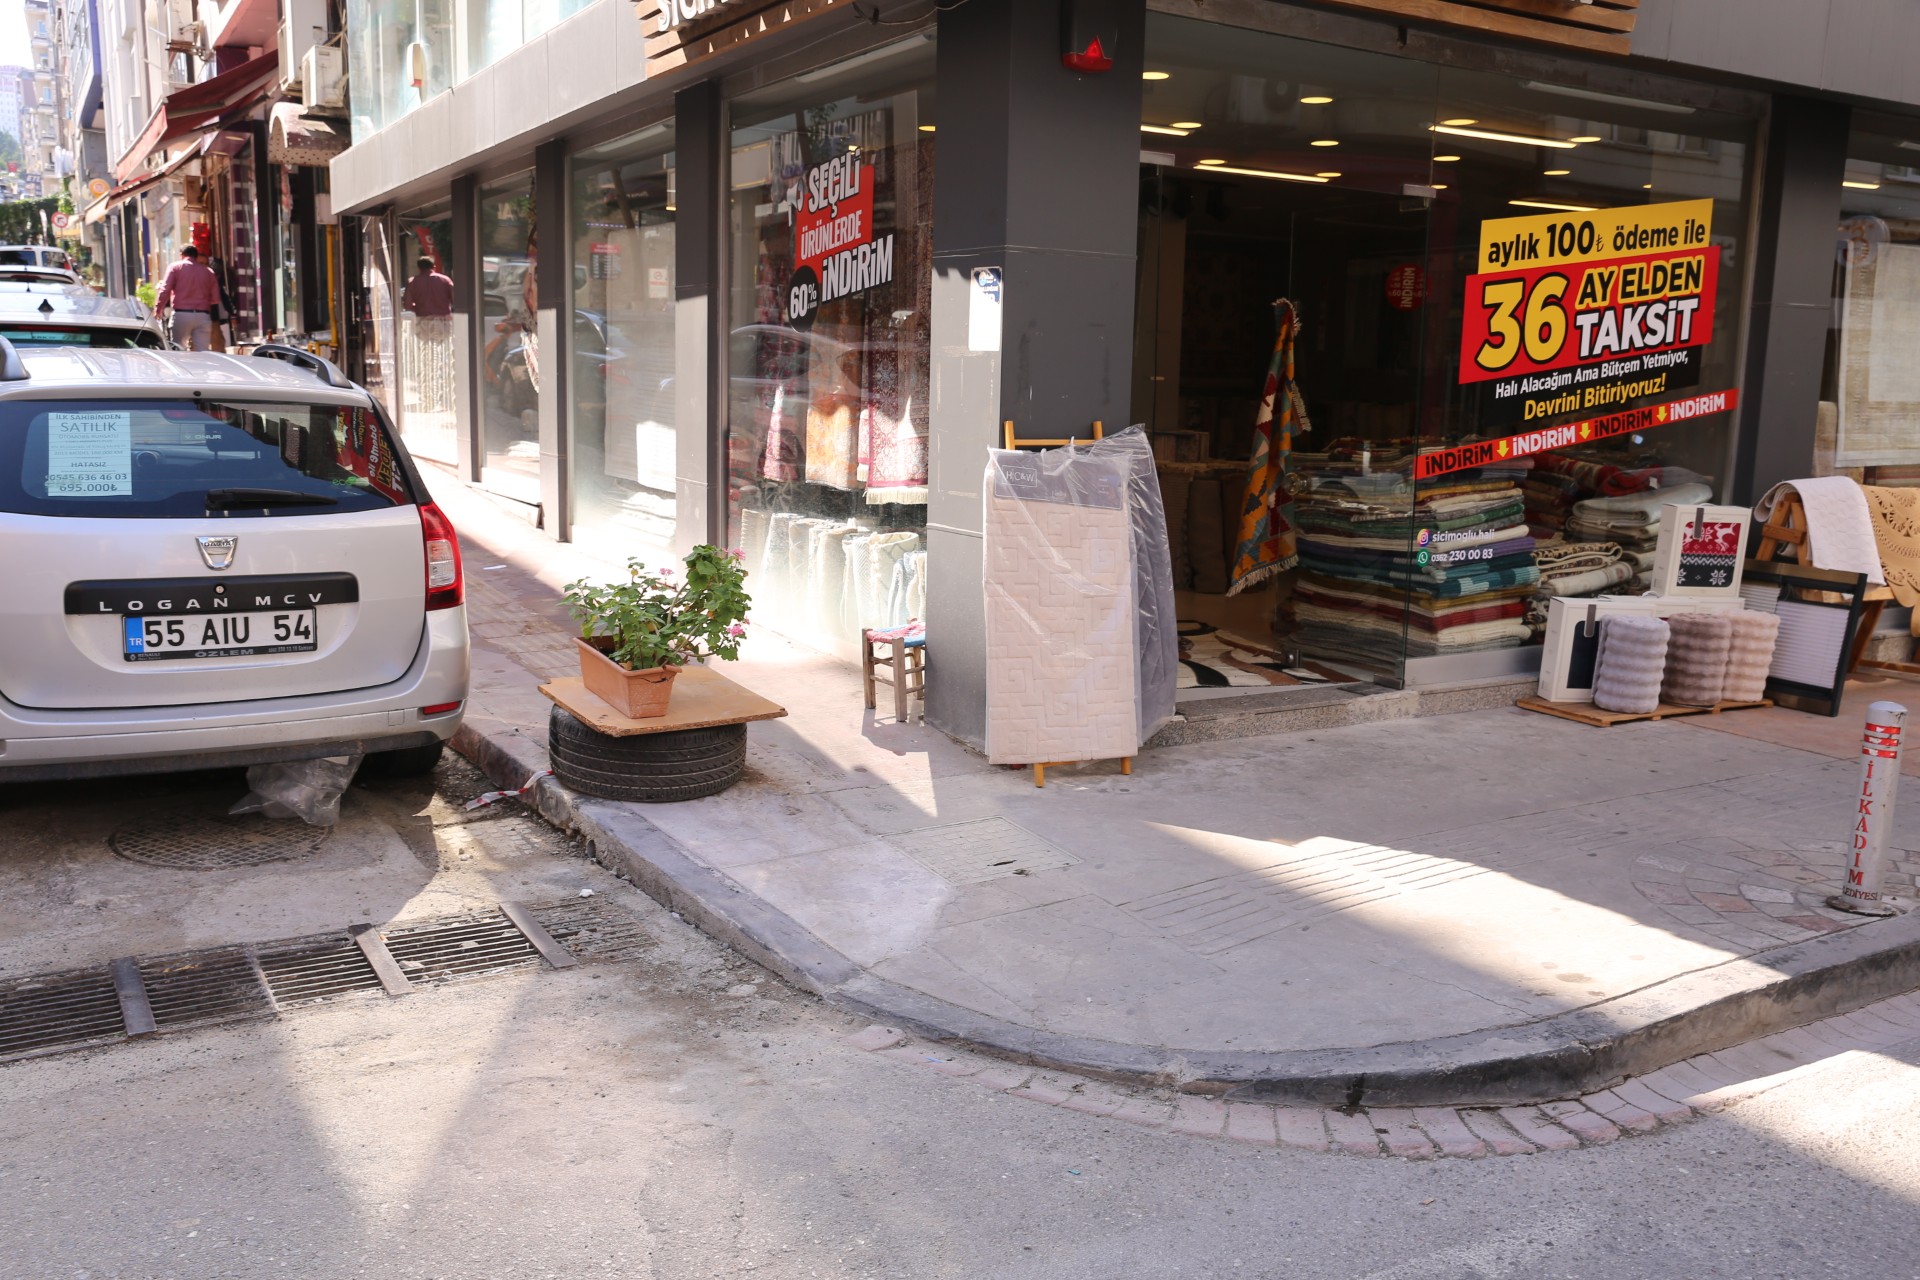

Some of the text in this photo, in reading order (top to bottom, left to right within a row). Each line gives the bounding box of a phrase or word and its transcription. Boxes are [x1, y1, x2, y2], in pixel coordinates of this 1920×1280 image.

[808, 148, 861, 218] SEÇİLİ
[801, 209, 862, 260] ÜRÜNLERDE
[1488, 231, 1540, 267] aylık
[1612, 224, 1679, 252] ödeme
[1683, 218, 1706, 245] ile
[822, 233, 893, 302] İNDİRİM
[1400, 267, 1416, 308] İNDİRİM
[790, 282, 817, 320] 60%
[1474, 272, 1569, 372] 36
[1576, 267, 1616, 308] AY
[1619, 255, 1704, 303] ELDEN
[1576, 297, 1699, 358] TAKSİT
[1495, 351, 1689, 399] Halı Alacağım Ama Bütçem Yetmiyor,
[1524, 372, 1667, 421] Devrini Bitiriyoruz!
[60, 422, 117, 432] SATILIK
[1425, 393, 1726, 476] İNDİRİM İNDİRİM İNDİRİM İNDİRİM
[1432, 529, 1495, 543] sicimoglu.hali
[1449, 550, 1466, 561] 230
[1468, 549, 1480, 560] 00
[1482, 548, 1493, 559] 83
[99, 593, 322, 612] LOGAN MCV
[129, 614, 311, 648] TR 55 AIU 54
[195, 648, 254, 658] ÖZLEM
[1847, 760, 1873, 887] İLKADIM
